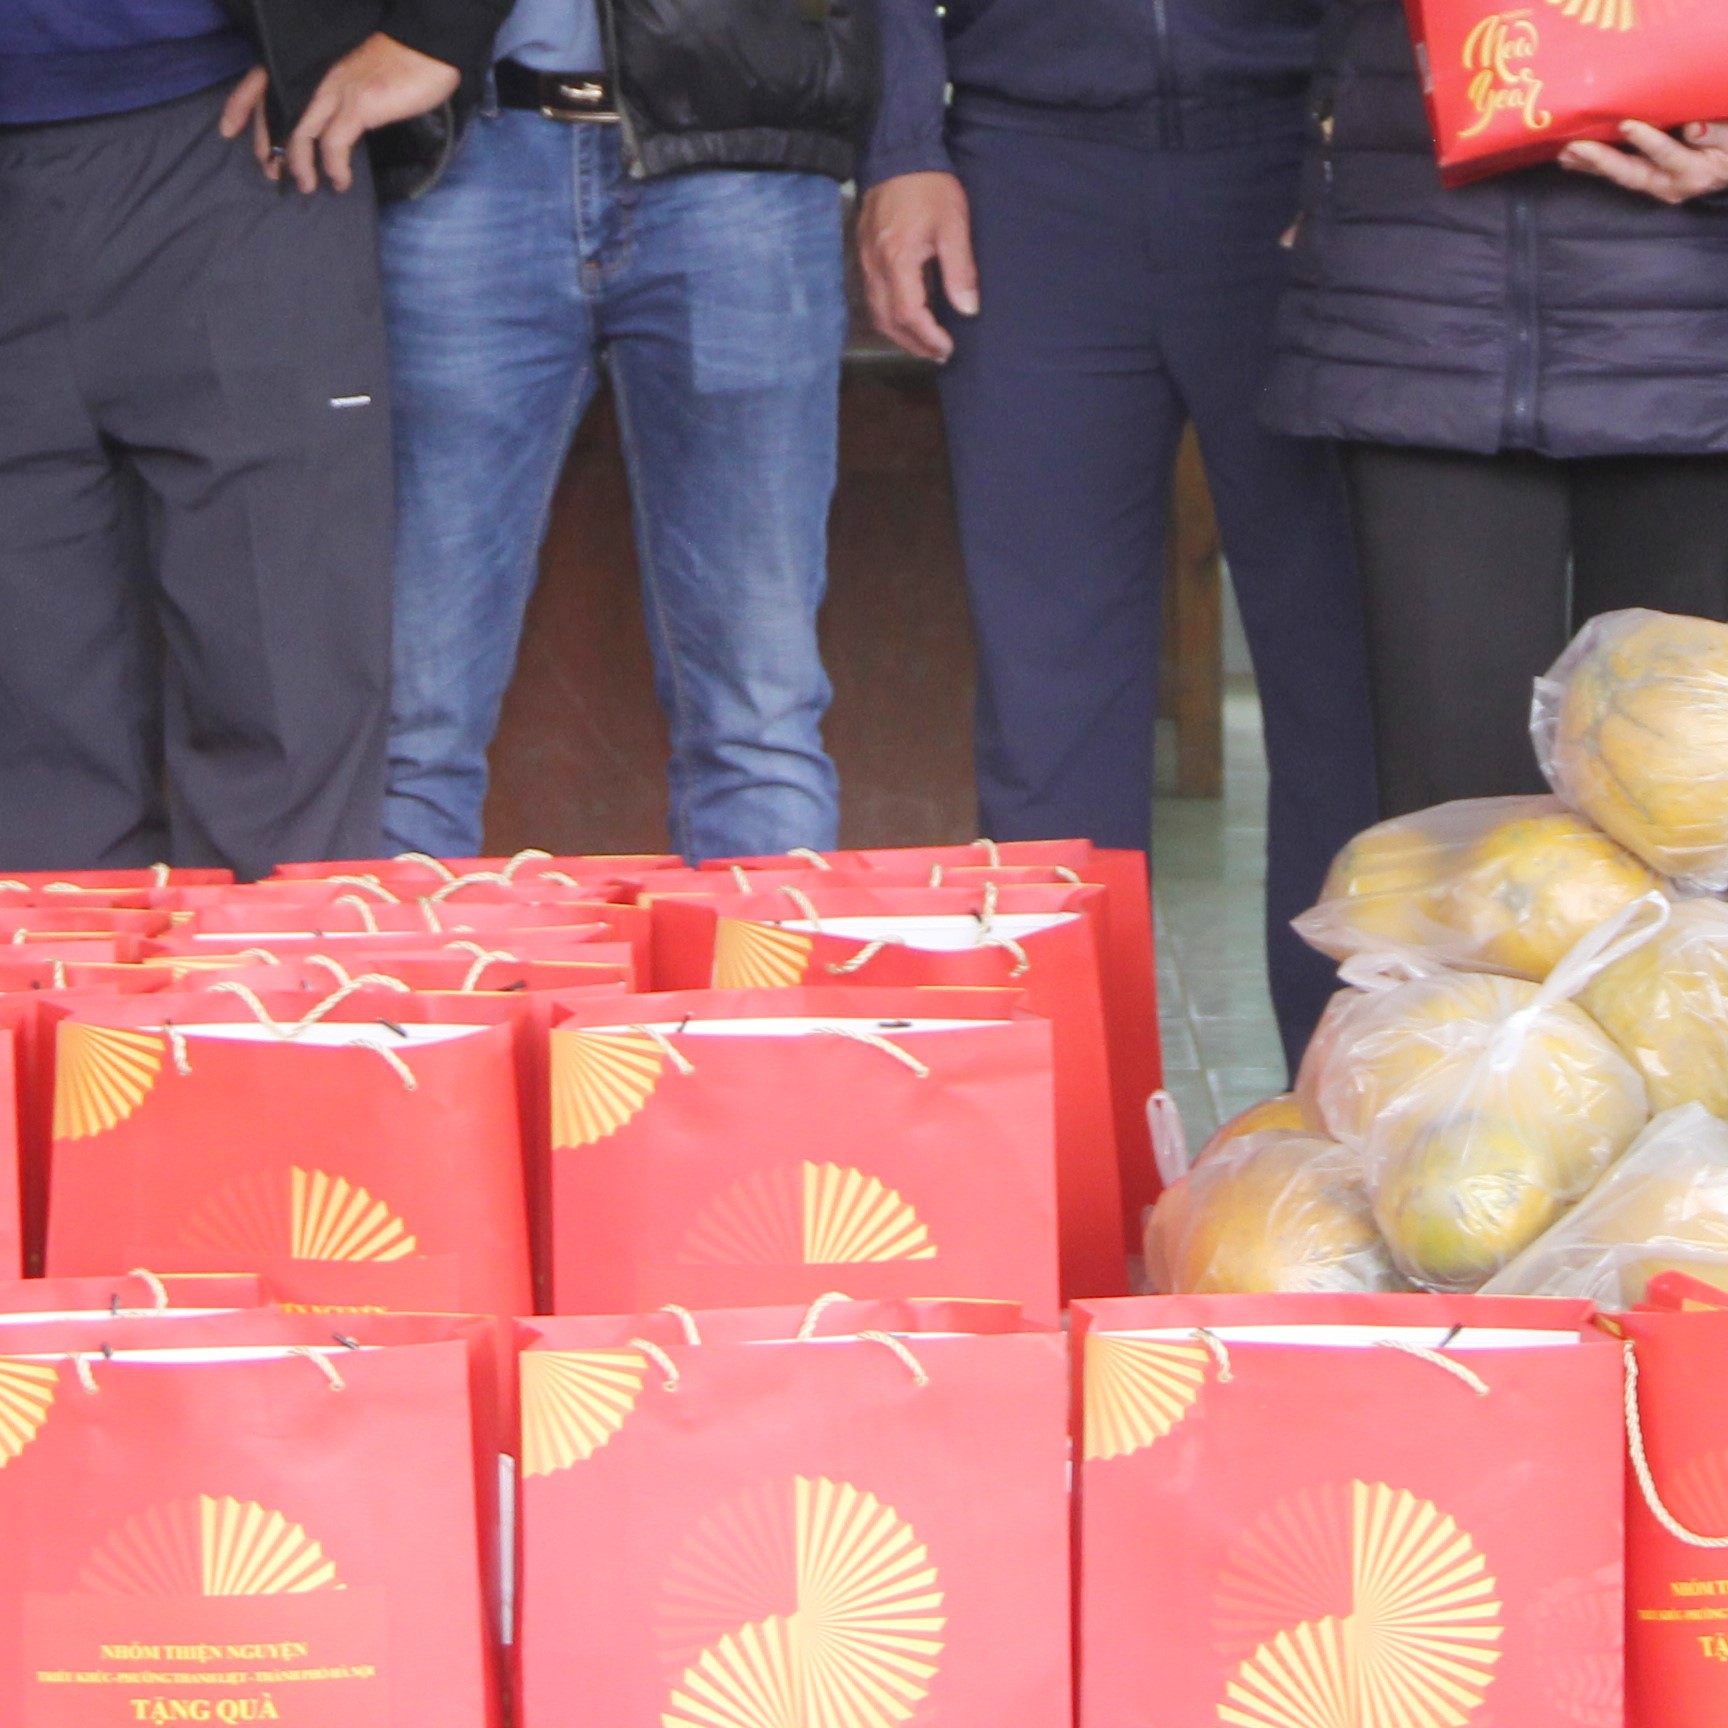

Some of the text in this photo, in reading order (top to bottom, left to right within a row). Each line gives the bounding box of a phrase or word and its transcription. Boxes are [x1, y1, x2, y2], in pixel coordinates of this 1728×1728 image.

[163, 1641, 223, 1663] THIỆN
[227, 1640, 308, 1661] NGUYỆN
[130, 1692, 280, 1726] TẶNG QUÀ
